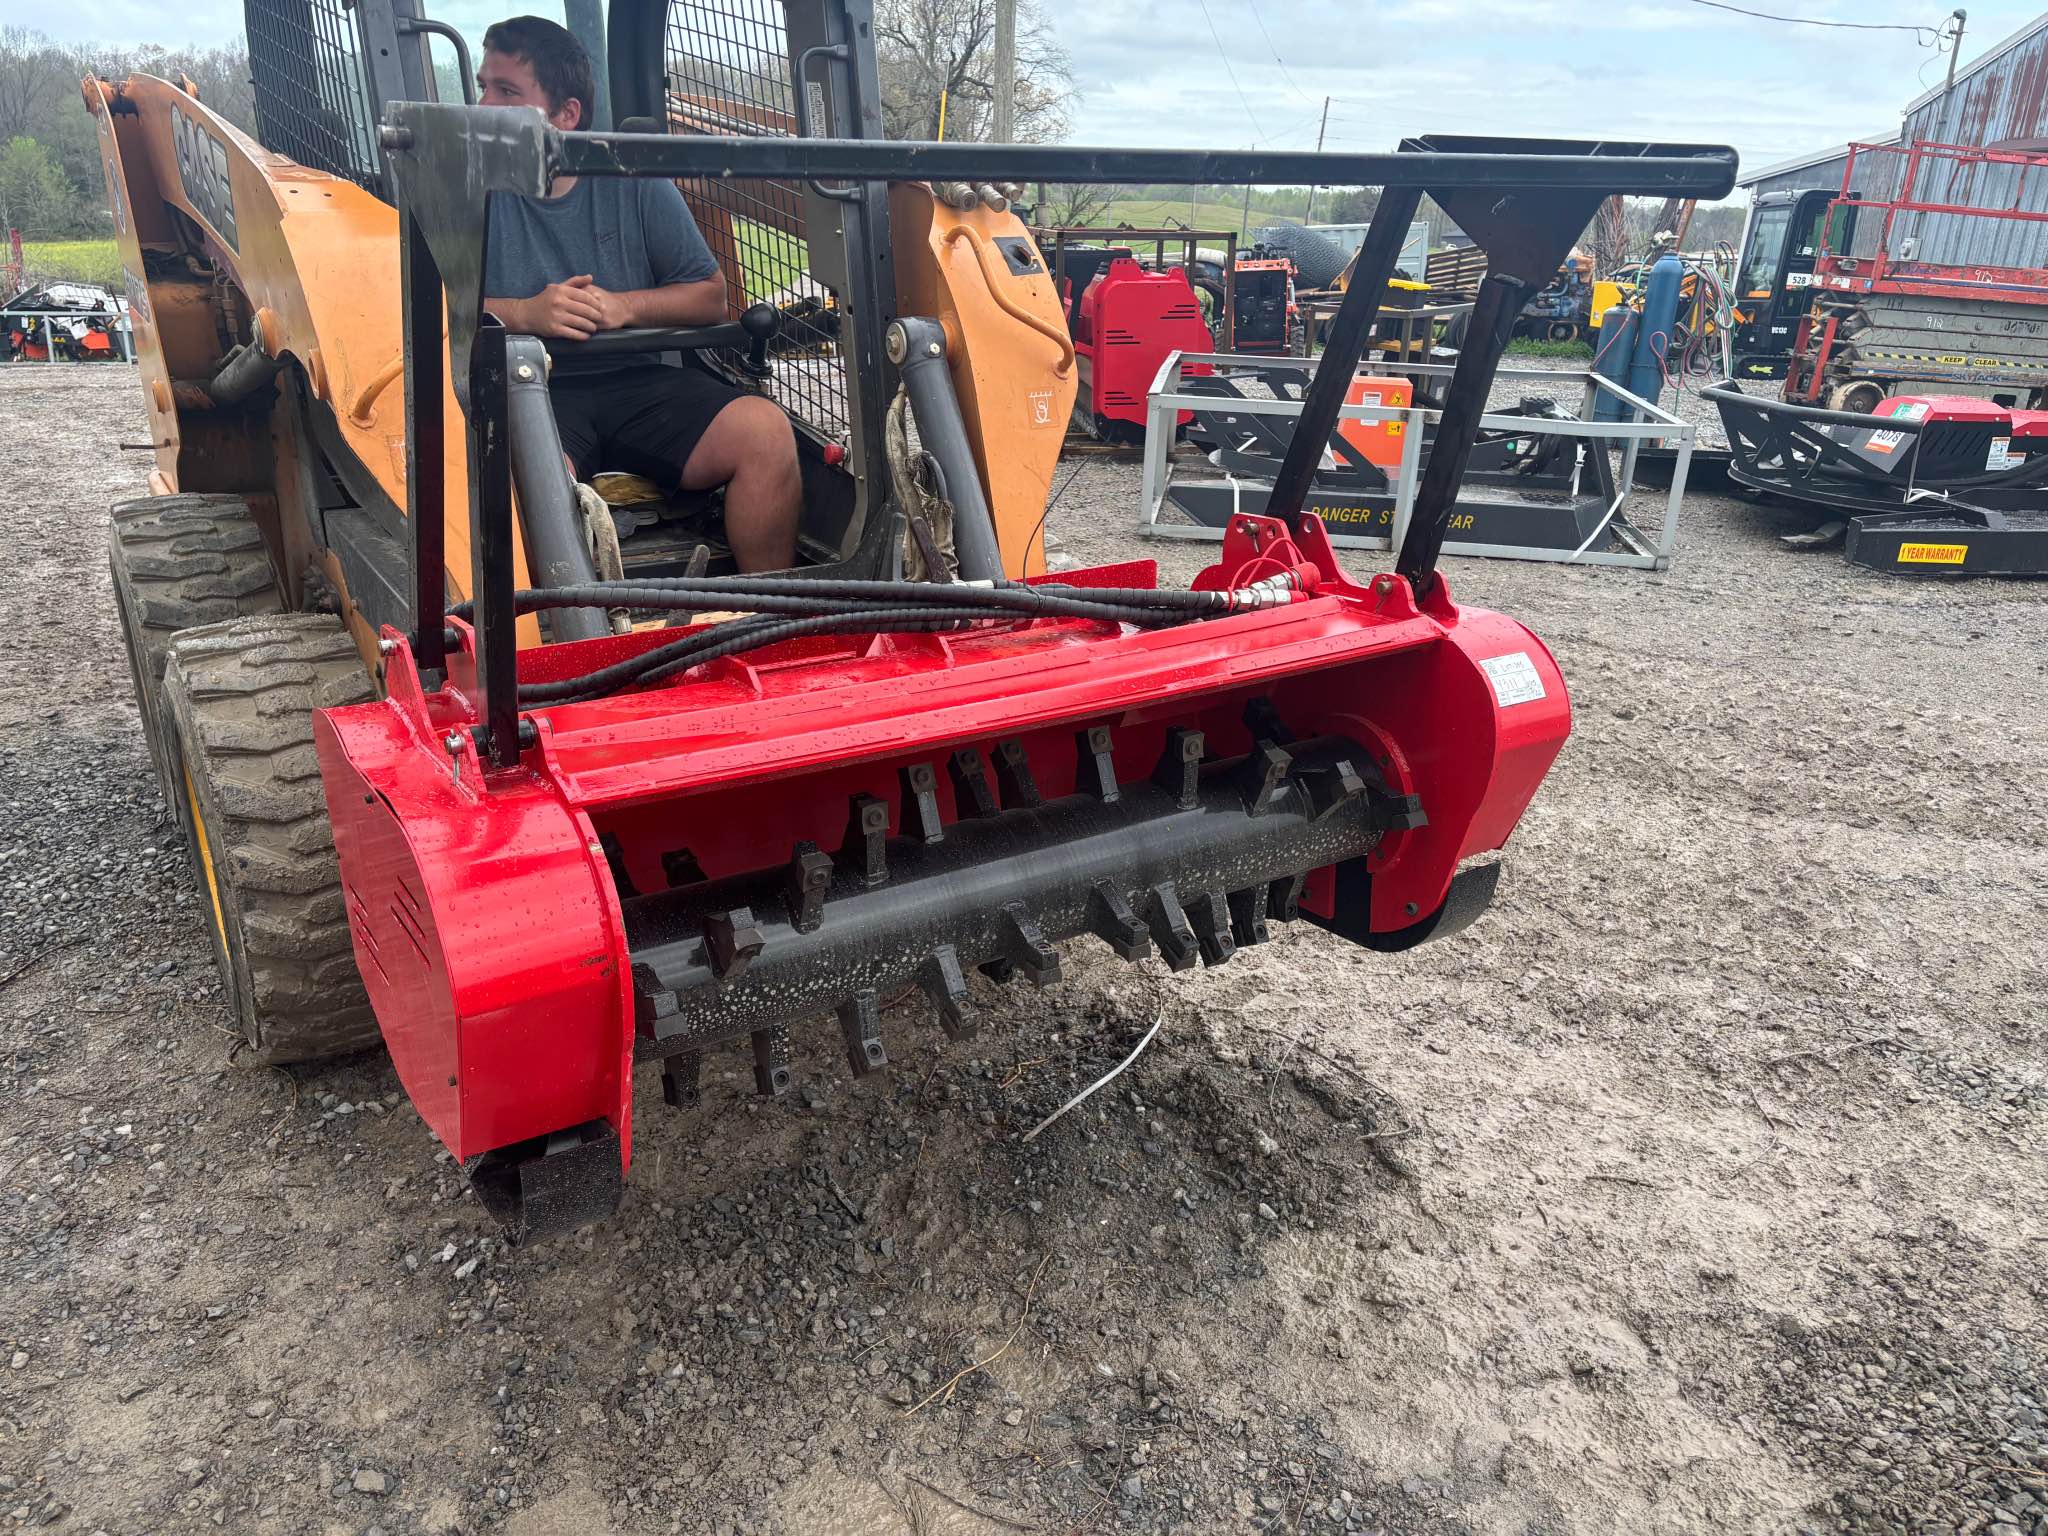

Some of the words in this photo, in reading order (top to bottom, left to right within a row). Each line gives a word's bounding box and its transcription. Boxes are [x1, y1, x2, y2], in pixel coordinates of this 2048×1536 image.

[171, 102, 240, 256] CASE
[1792, 276, 1807, 285] 528
[1974, 358, 1997, 366] CLEAR
[1952, 371, 2001, 382] SKYJACK
[1311, 506, 1370, 524] DANGER
[1906, 547, 1925, 560] YEAR
[1925, 547, 1964, 561] WARRANTY
